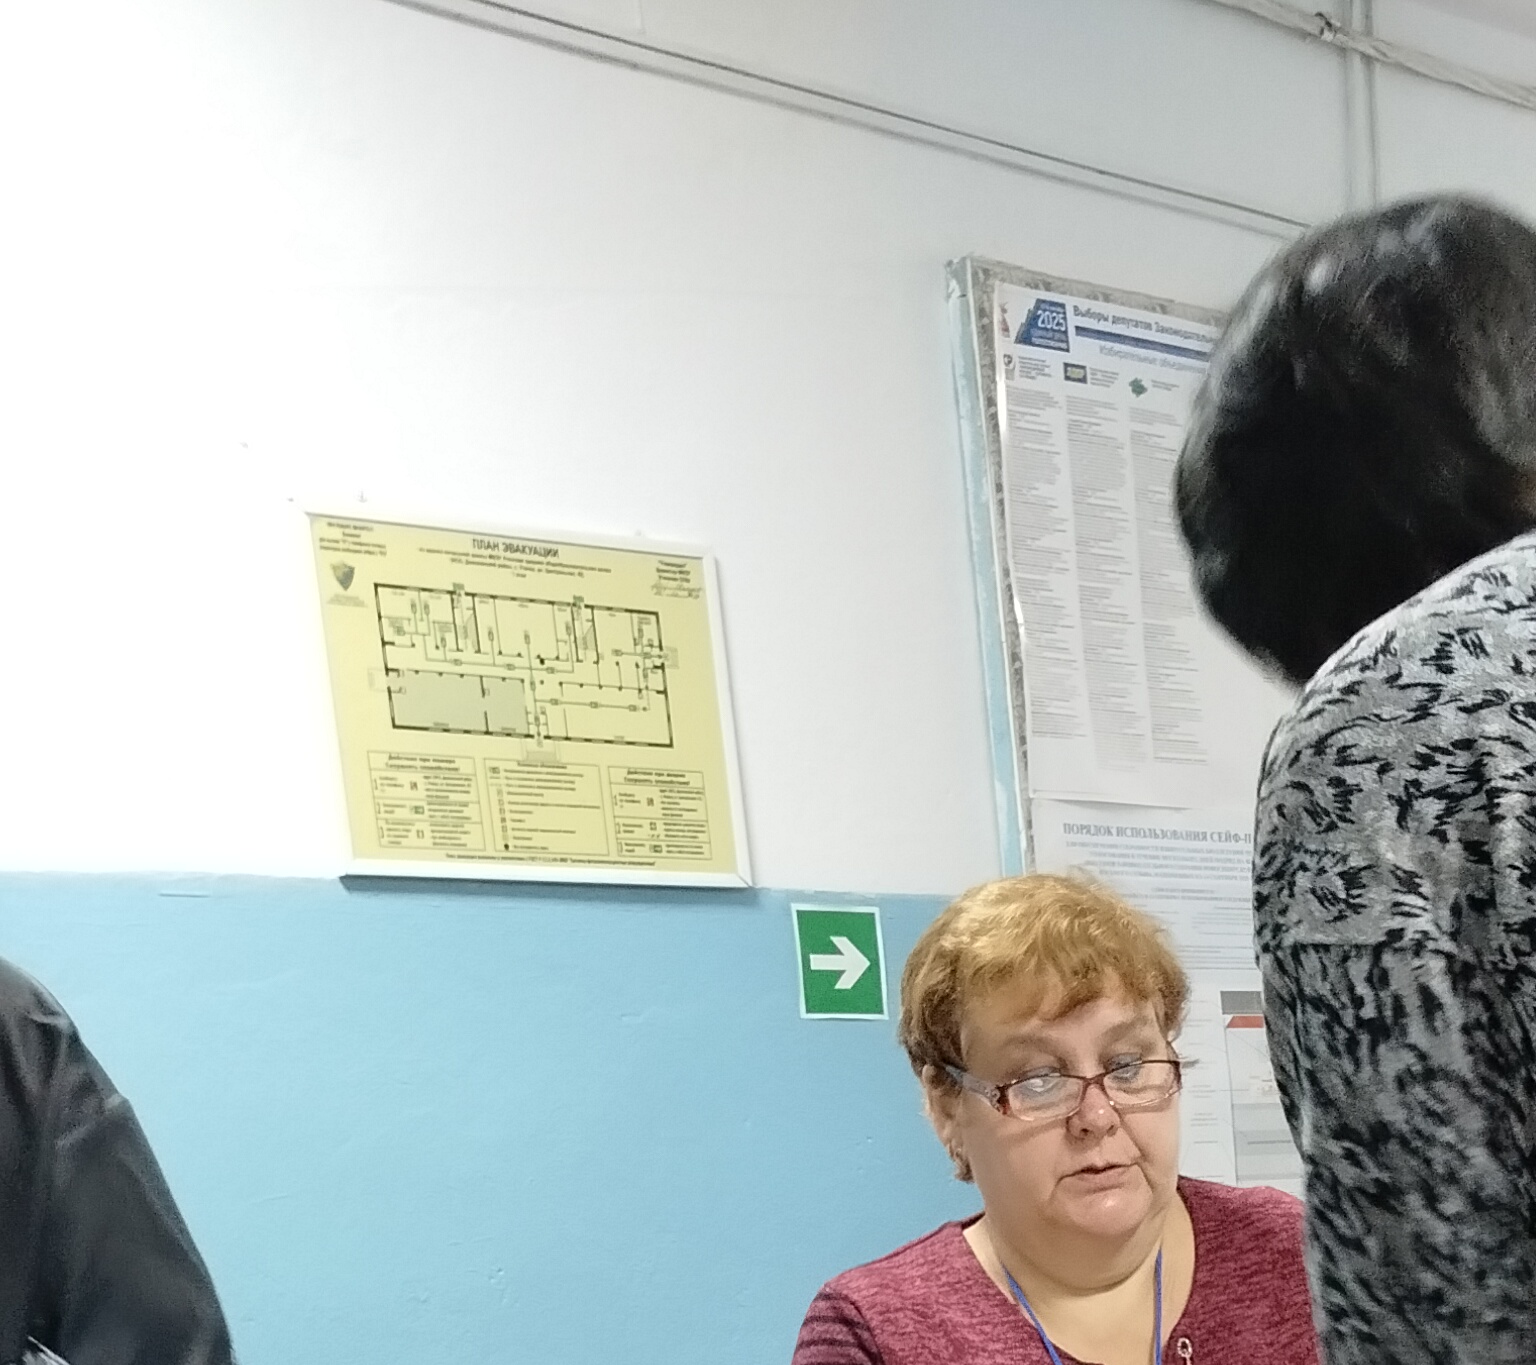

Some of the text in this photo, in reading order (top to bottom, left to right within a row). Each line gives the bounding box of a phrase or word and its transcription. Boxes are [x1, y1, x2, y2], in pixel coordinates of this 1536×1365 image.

[1037, 310, 1066, 331] 2025
[472, 538, 560, 559] ПЛАН ЭВАКУАЦИИ
[1063, 823, 1114, 837] ПОРЯДОК
[1116, 826, 1208, 842] ИСПОЛЬЗОВАНИЯ
